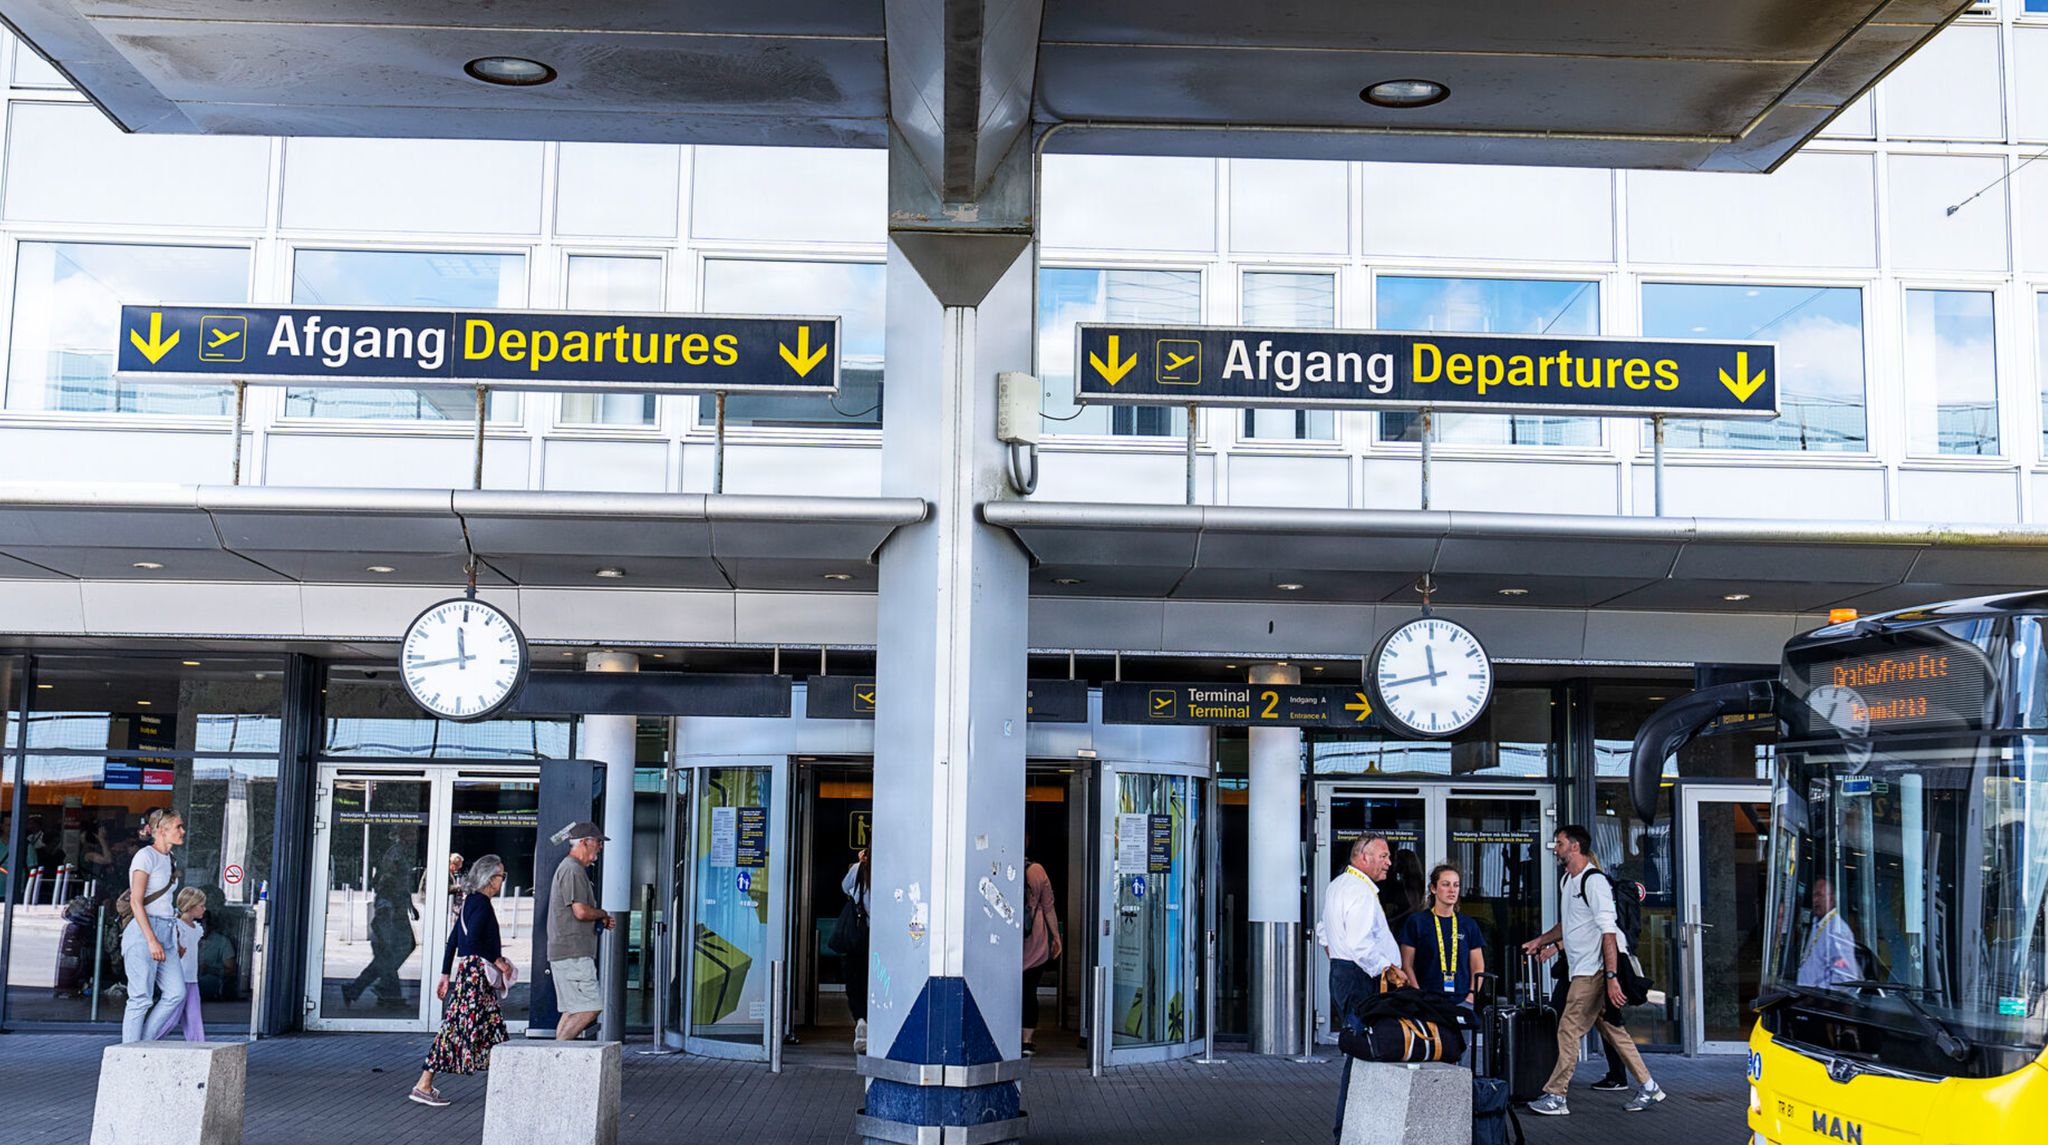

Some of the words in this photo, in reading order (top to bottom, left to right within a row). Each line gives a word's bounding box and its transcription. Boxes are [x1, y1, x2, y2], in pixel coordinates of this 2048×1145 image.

[267, 315, 446, 370] Afgang
[464, 319, 738, 371] Departures
[1221, 339, 1394, 394] Afgang
[1412, 342, 1680, 394] Departures
[1188, 688, 1250, 702] Terminal
[1260, 690, 1279, 719] 2
[1289, 696, 1318, 705] Indgang
[1320, 696, 1327, 704] A
[1188, 704, 1250, 719] Terminal
[1289, 711, 1320, 720] Entrance
[1320, 712, 1327, 720] A
[1812, 1109, 1863, 1145] MAN
